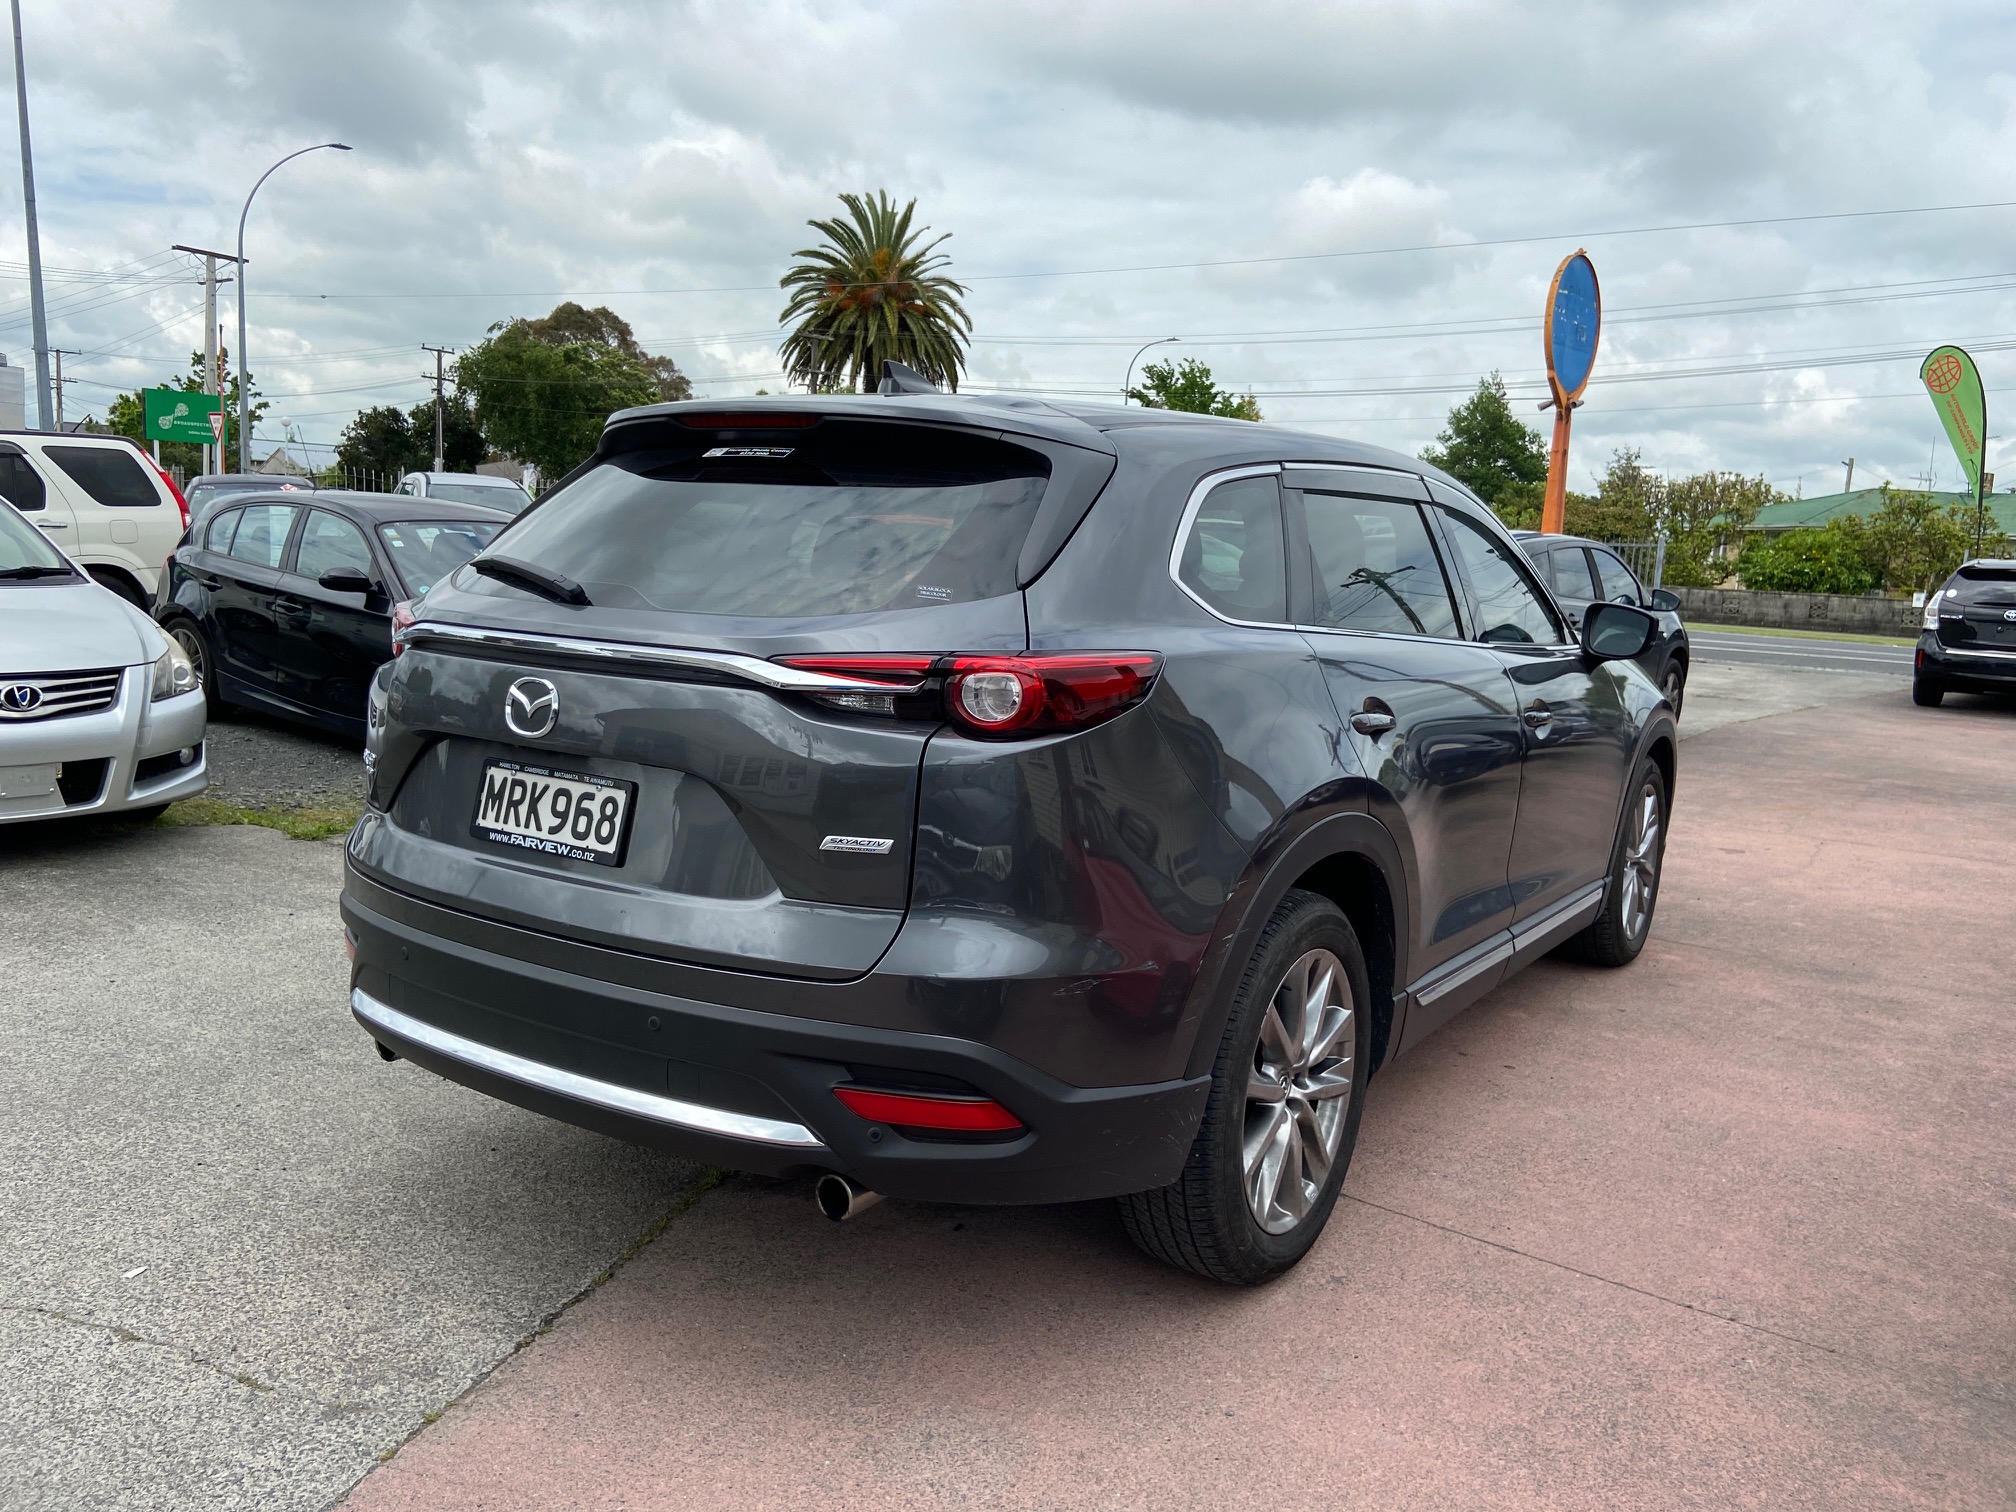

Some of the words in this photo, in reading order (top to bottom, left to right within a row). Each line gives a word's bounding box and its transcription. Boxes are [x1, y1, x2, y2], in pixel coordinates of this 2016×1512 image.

[499, 761, 521, 771] HAMILTON
[524, 766, 550, 776] CAMBRIDGE
[554, 771, 579, 781] MATAMATA
[583, 775, 591, 784] TE
[590, 776, 615, 787] AWAMUTU
[481, 773, 620, 845] MRK968
[829, 838, 886, 847] SKYACTIV
